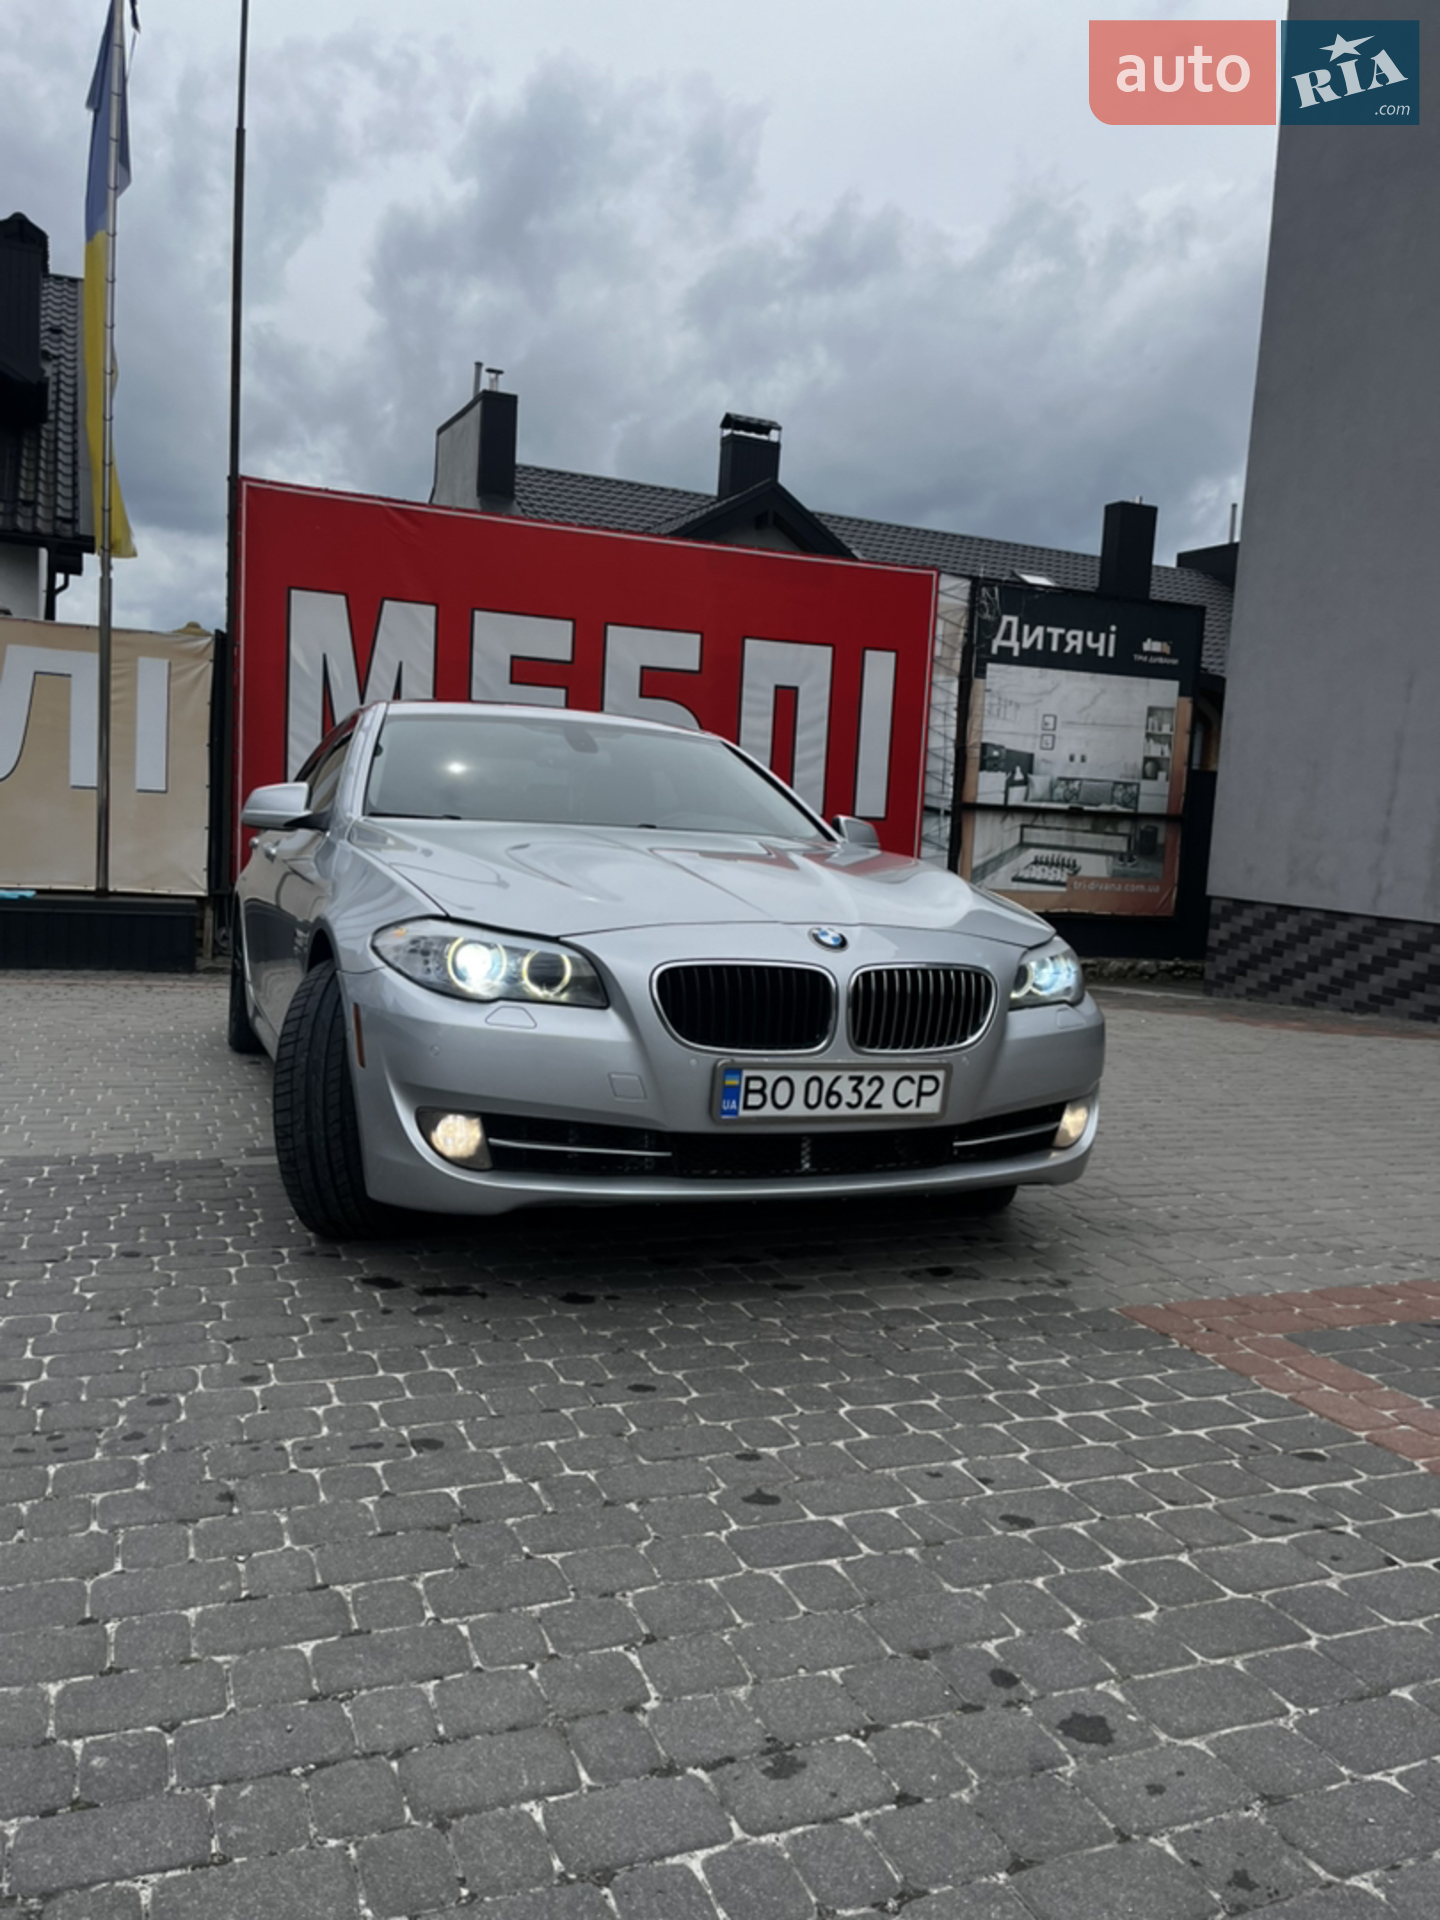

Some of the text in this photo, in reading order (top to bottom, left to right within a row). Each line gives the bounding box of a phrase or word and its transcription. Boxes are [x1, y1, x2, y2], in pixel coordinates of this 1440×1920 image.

[991, 614, 1117, 658] Дитячі
[722, 1100, 737, 1110] UA
[742, 1074, 940, 1111] BO 0632 CP
